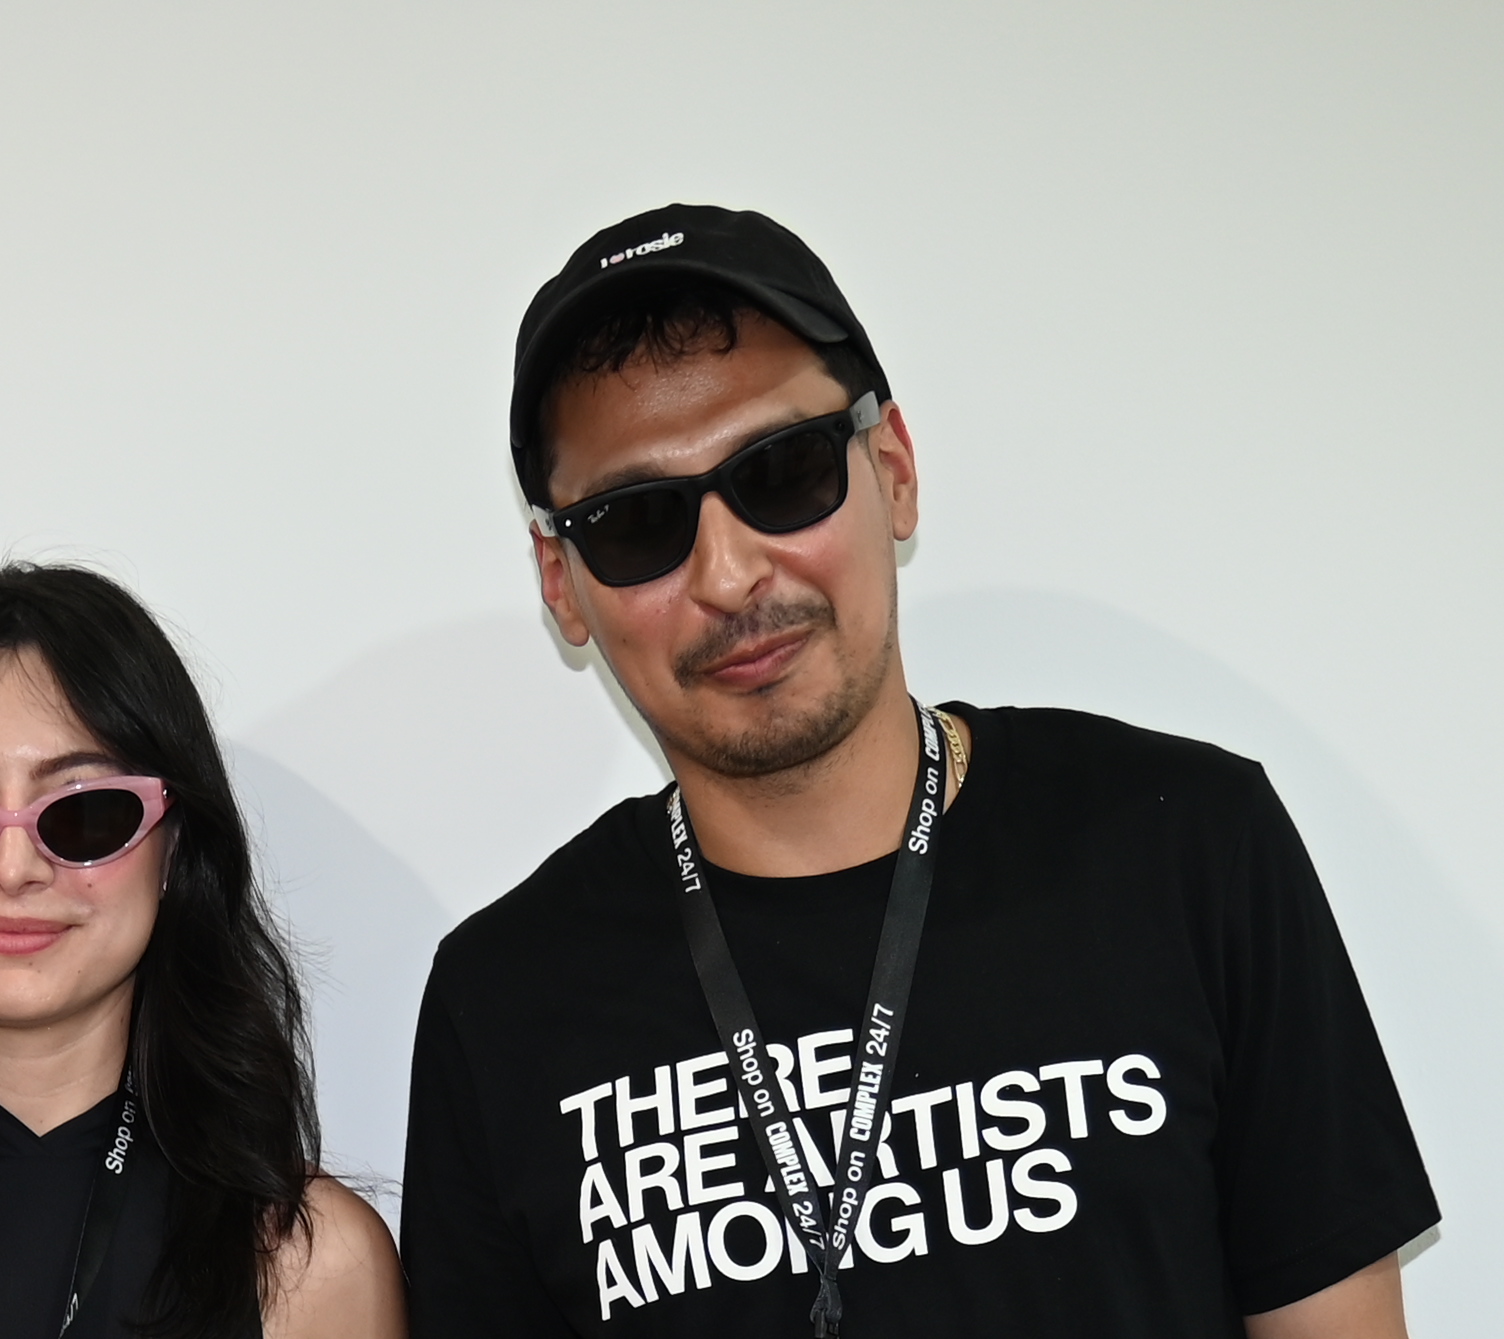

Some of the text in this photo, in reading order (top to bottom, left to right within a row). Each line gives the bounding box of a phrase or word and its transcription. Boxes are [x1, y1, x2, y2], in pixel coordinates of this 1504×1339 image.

[909, 799, 937, 854] Shop
[925, 767, 939, 795] on
[677, 848, 701, 893] 24/7
[105, 1126, 132, 1174] Shop
[733, 1028, 826, 1250] Shop on COMPLEX 24/7
[833, 1003, 894, 1250] Shop on COMPLEX 24/7
[579, 1125, 745, 1244] ARE
[942, 1148, 1079, 1246] US
